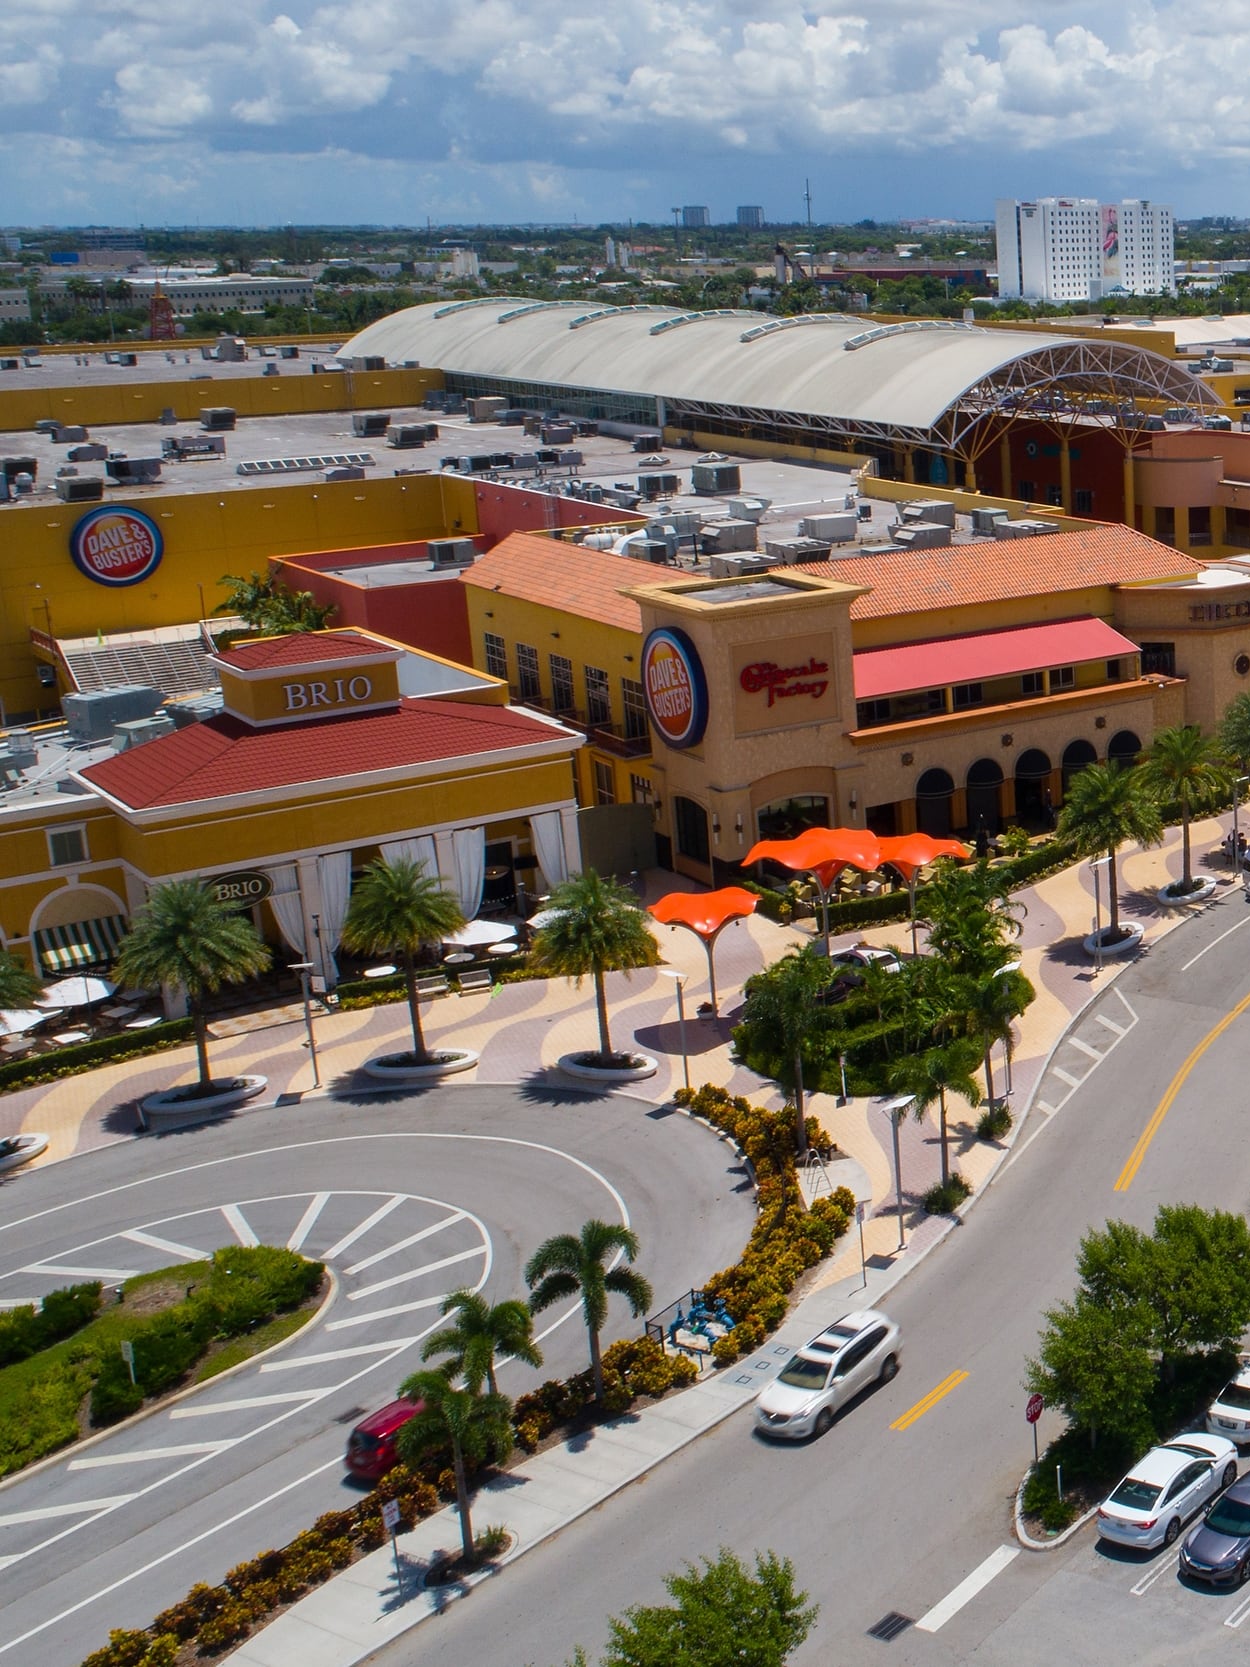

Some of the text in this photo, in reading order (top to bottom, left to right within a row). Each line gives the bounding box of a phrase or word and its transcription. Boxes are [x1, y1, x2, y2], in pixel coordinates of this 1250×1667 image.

[87, 523, 148, 555] DAVE &
[91, 540, 152, 570] BUSTER'S
[649, 658, 687, 693] DAVE &
[283, 676, 372, 711] BRIO
[653, 686, 691, 718] BUSTER'S
[215, 879, 262, 901] BRIO
[1027, 1398, 1042, 1419] STOP
